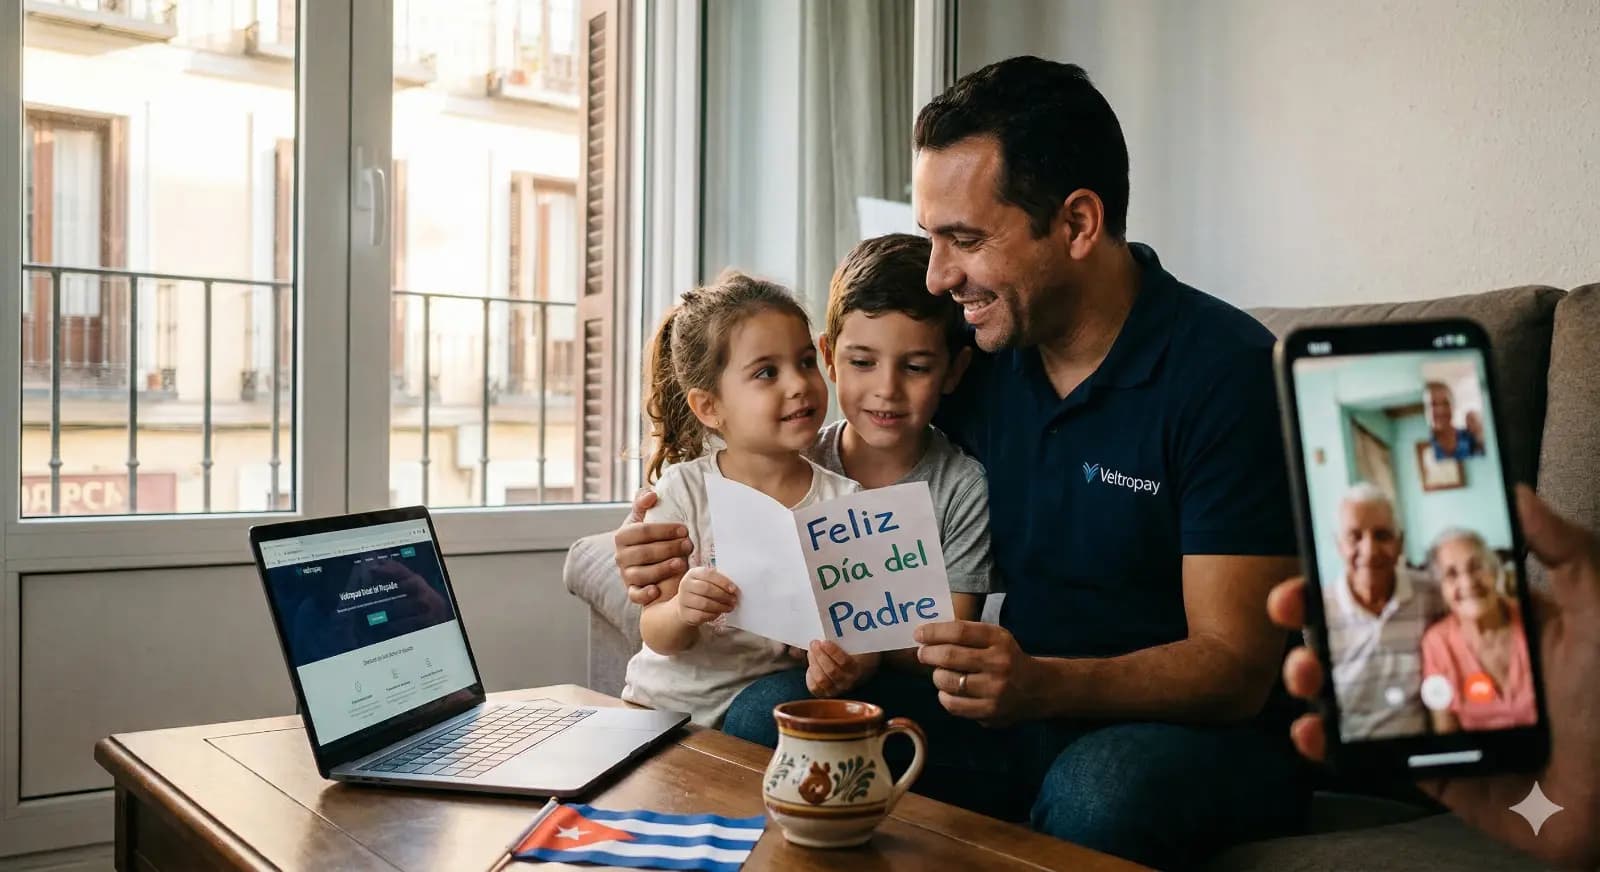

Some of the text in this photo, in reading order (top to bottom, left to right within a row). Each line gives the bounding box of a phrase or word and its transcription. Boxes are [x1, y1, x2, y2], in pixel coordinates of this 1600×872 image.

[1100, 467, 1160, 495] Veltropay
[807, 508, 900, 551] Feliz
[817, 539, 928, 590] Día del
[829, 591, 939, 638] Padre
